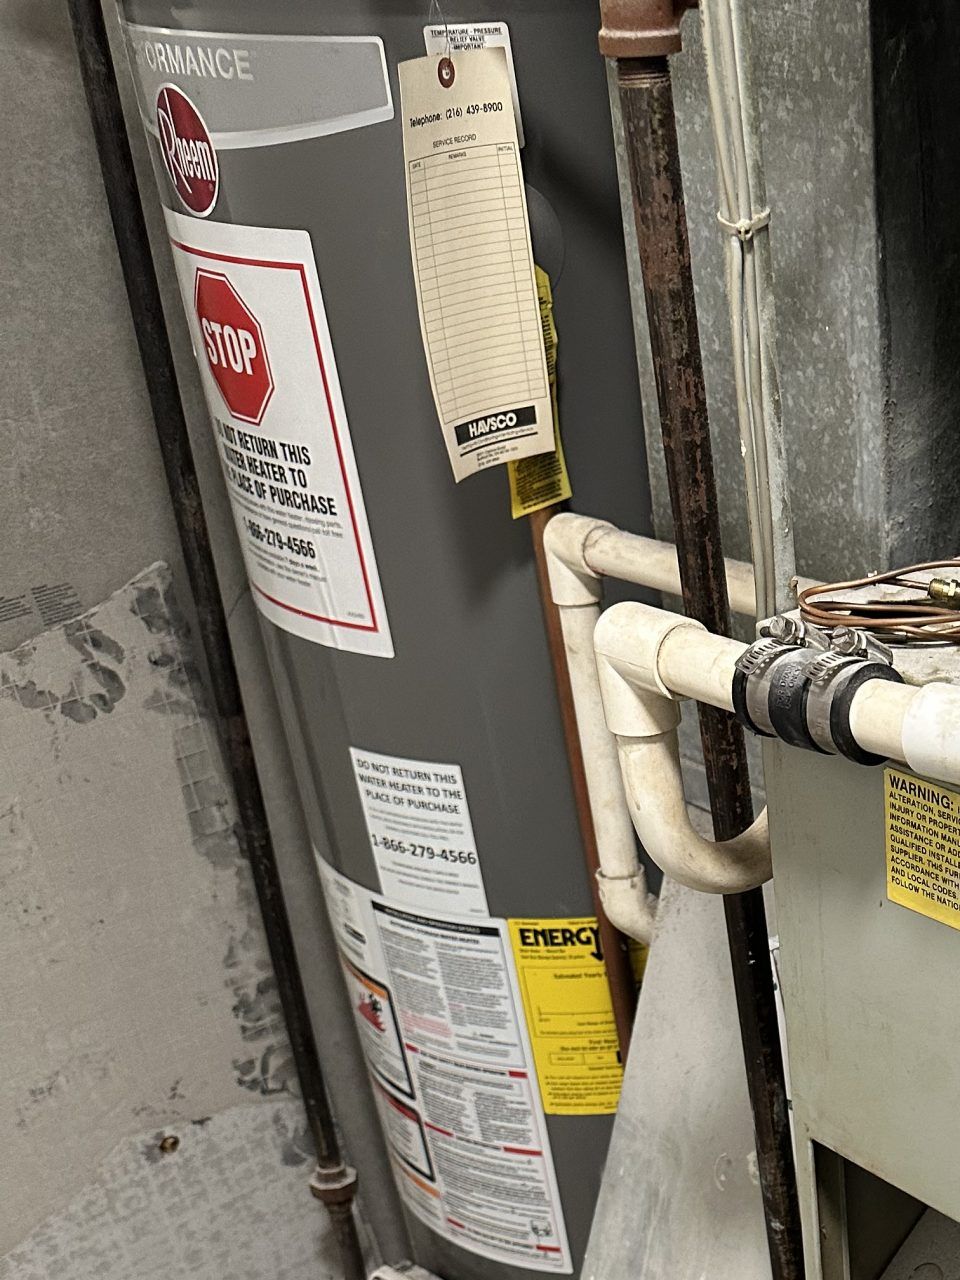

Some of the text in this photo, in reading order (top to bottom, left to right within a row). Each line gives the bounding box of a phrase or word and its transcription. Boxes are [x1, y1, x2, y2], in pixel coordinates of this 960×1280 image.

[431, 27, 502, 37] TEMPRATURE PRESSURE
[142, 40, 254, 81] ORMANCE
[409, 102, 503, 128] Telephone: (216) 439-8900
[157, 88, 217, 194] Rheem
[432, 133, 477, 148] SERVICE RECORD
[201, 317, 257, 376] STOP
[468, 412, 517, 438] HAVSCO
[236, 429, 279, 460] RETURN
[279, 441, 312, 466] THIS
[246, 455, 288, 484] HEATER
[288, 467, 308, 489] TO
[254, 479, 267, 500] OF
[268, 485, 338, 517] PURCHASE
[356, 758, 458, 785] DO NOT RETURN THIS
[358, 774, 463, 801] WATER HEATER TO THE
[889, 774, 954, 812] WARNING:
[365, 789, 461, 815] PLACE OF PURCHASE
[889, 791, 936, 817] ALTERATION,
[889, 801, 914, 818] INJURY
[916, 812, 927, 823] OR
[889, 812, 939, 839] INFORMATION
[889, 824, 934, 847] ASSISTANCE
[935, 841, 946, 852] OR
[371, 833, 477, 865] 1-866-279-4566
[890, 834, 927, 855] QUALIFIED
[890, 844, 924, 865] SUPPLIER.
[926, 858, 943, 873] THIS
[890, 854, 940, 881] ACCORDANCE
[941, 875, 960, 890] WITH
[890, 865, 906, 877] AND
[907, 871, 931, 888] LOCAL
[932, 883, 959, 900] CODES.
[891, 876, 919, 894] FOLLOW
[921, 888, 936, 901] THE
